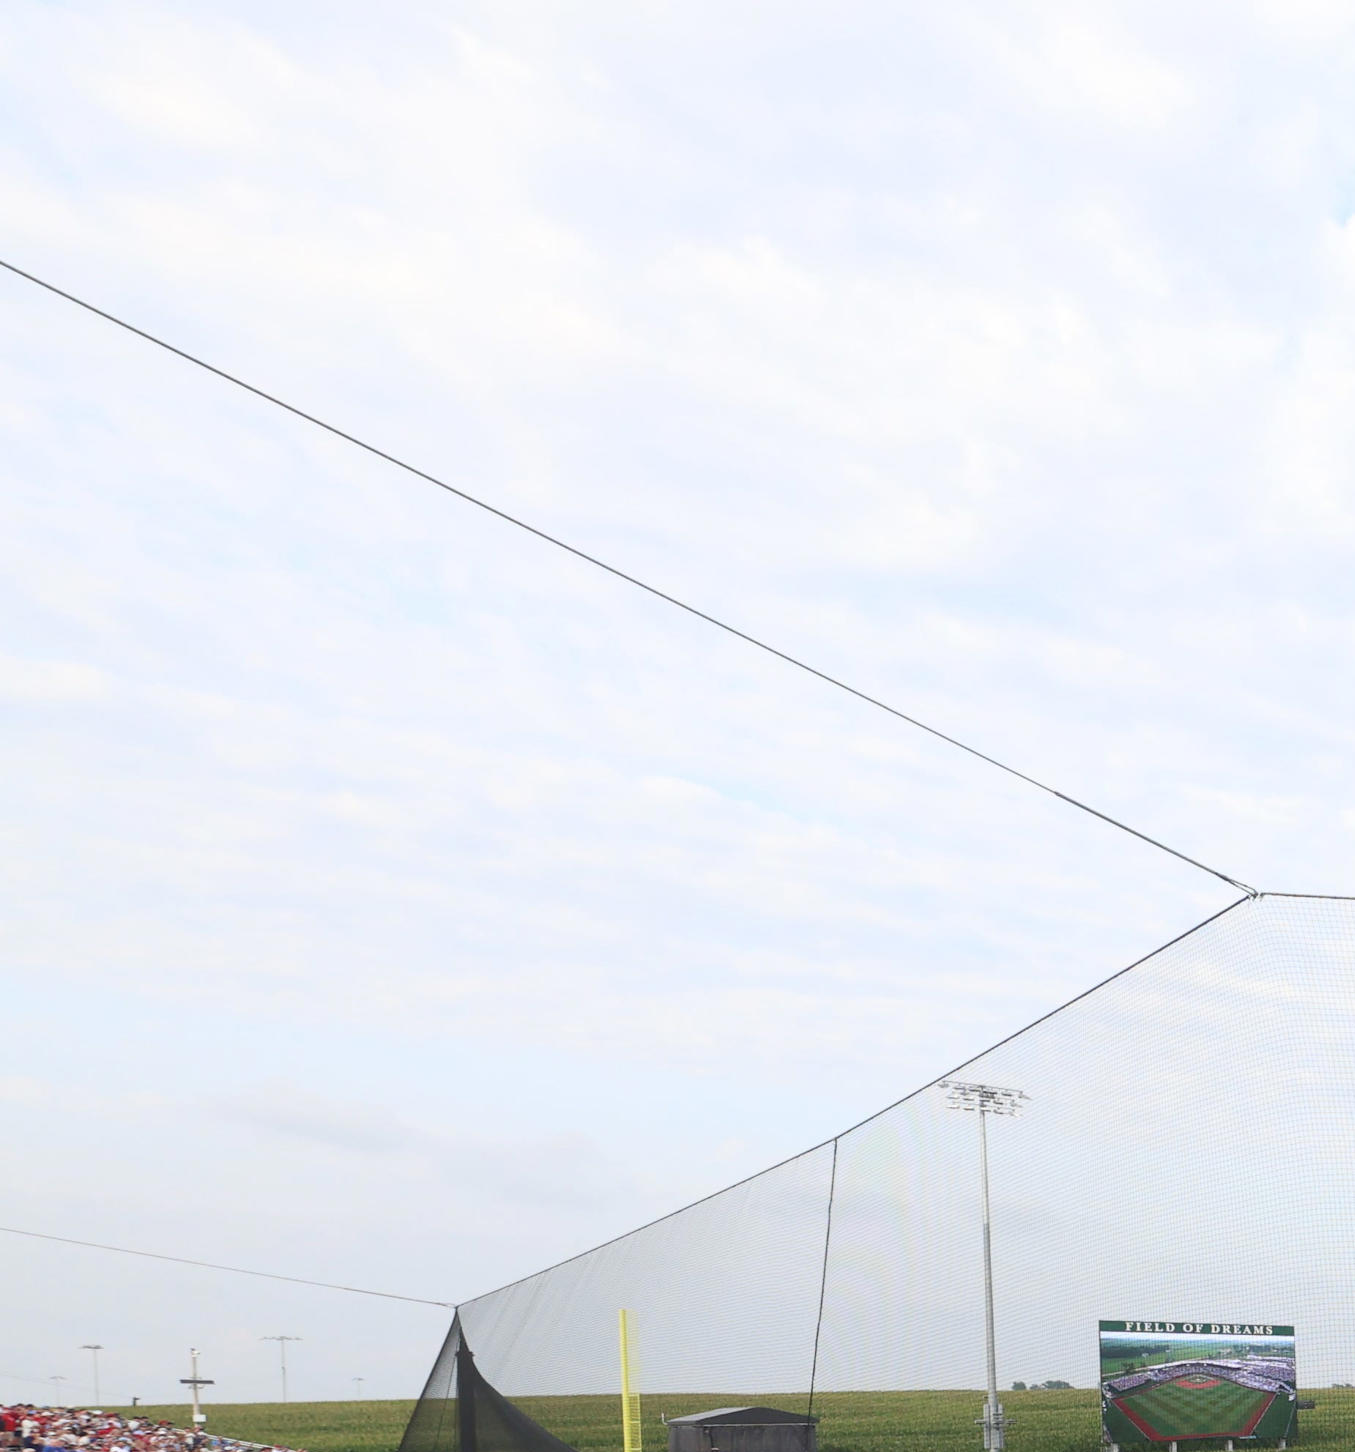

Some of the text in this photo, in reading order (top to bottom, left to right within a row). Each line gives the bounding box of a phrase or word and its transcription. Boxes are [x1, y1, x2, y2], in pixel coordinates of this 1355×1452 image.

[1125, 1322, 1273, 1335] FIELD OF DREAMS
